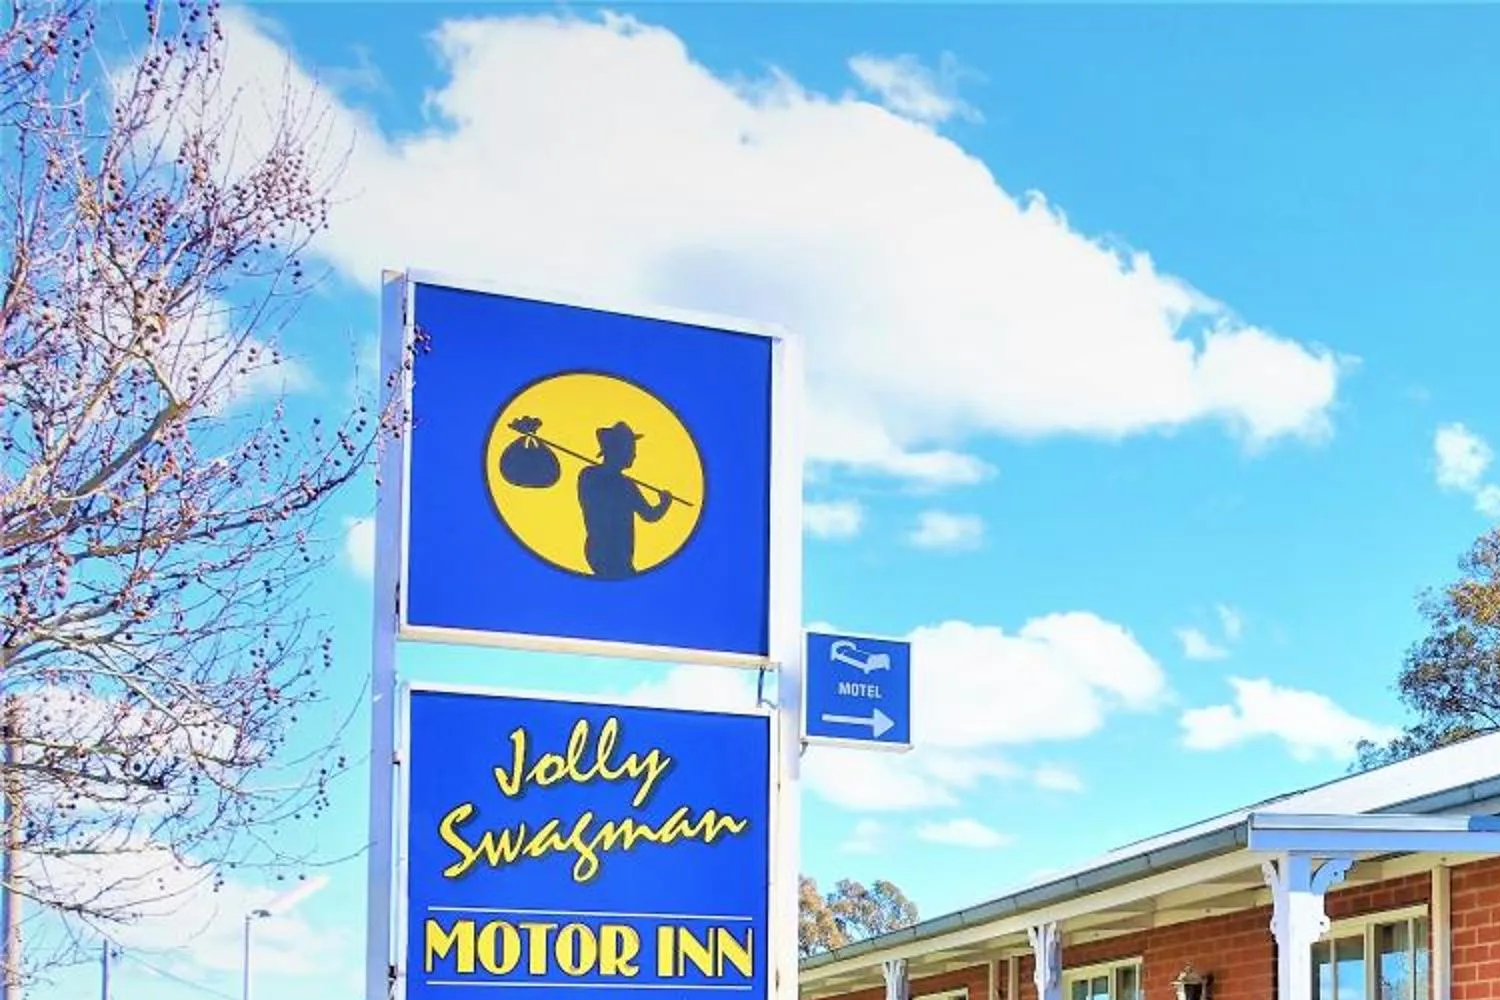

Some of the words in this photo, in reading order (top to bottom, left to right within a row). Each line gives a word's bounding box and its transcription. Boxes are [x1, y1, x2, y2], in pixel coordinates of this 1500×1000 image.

[838, 681, 882, 699] MOTEL
[494, 717, 671, 804] Jolly
[439, 803, 746, 881] Swagman
[424, 918, 640, 977] MOTOR
[657, 926, 754, 978] INN
